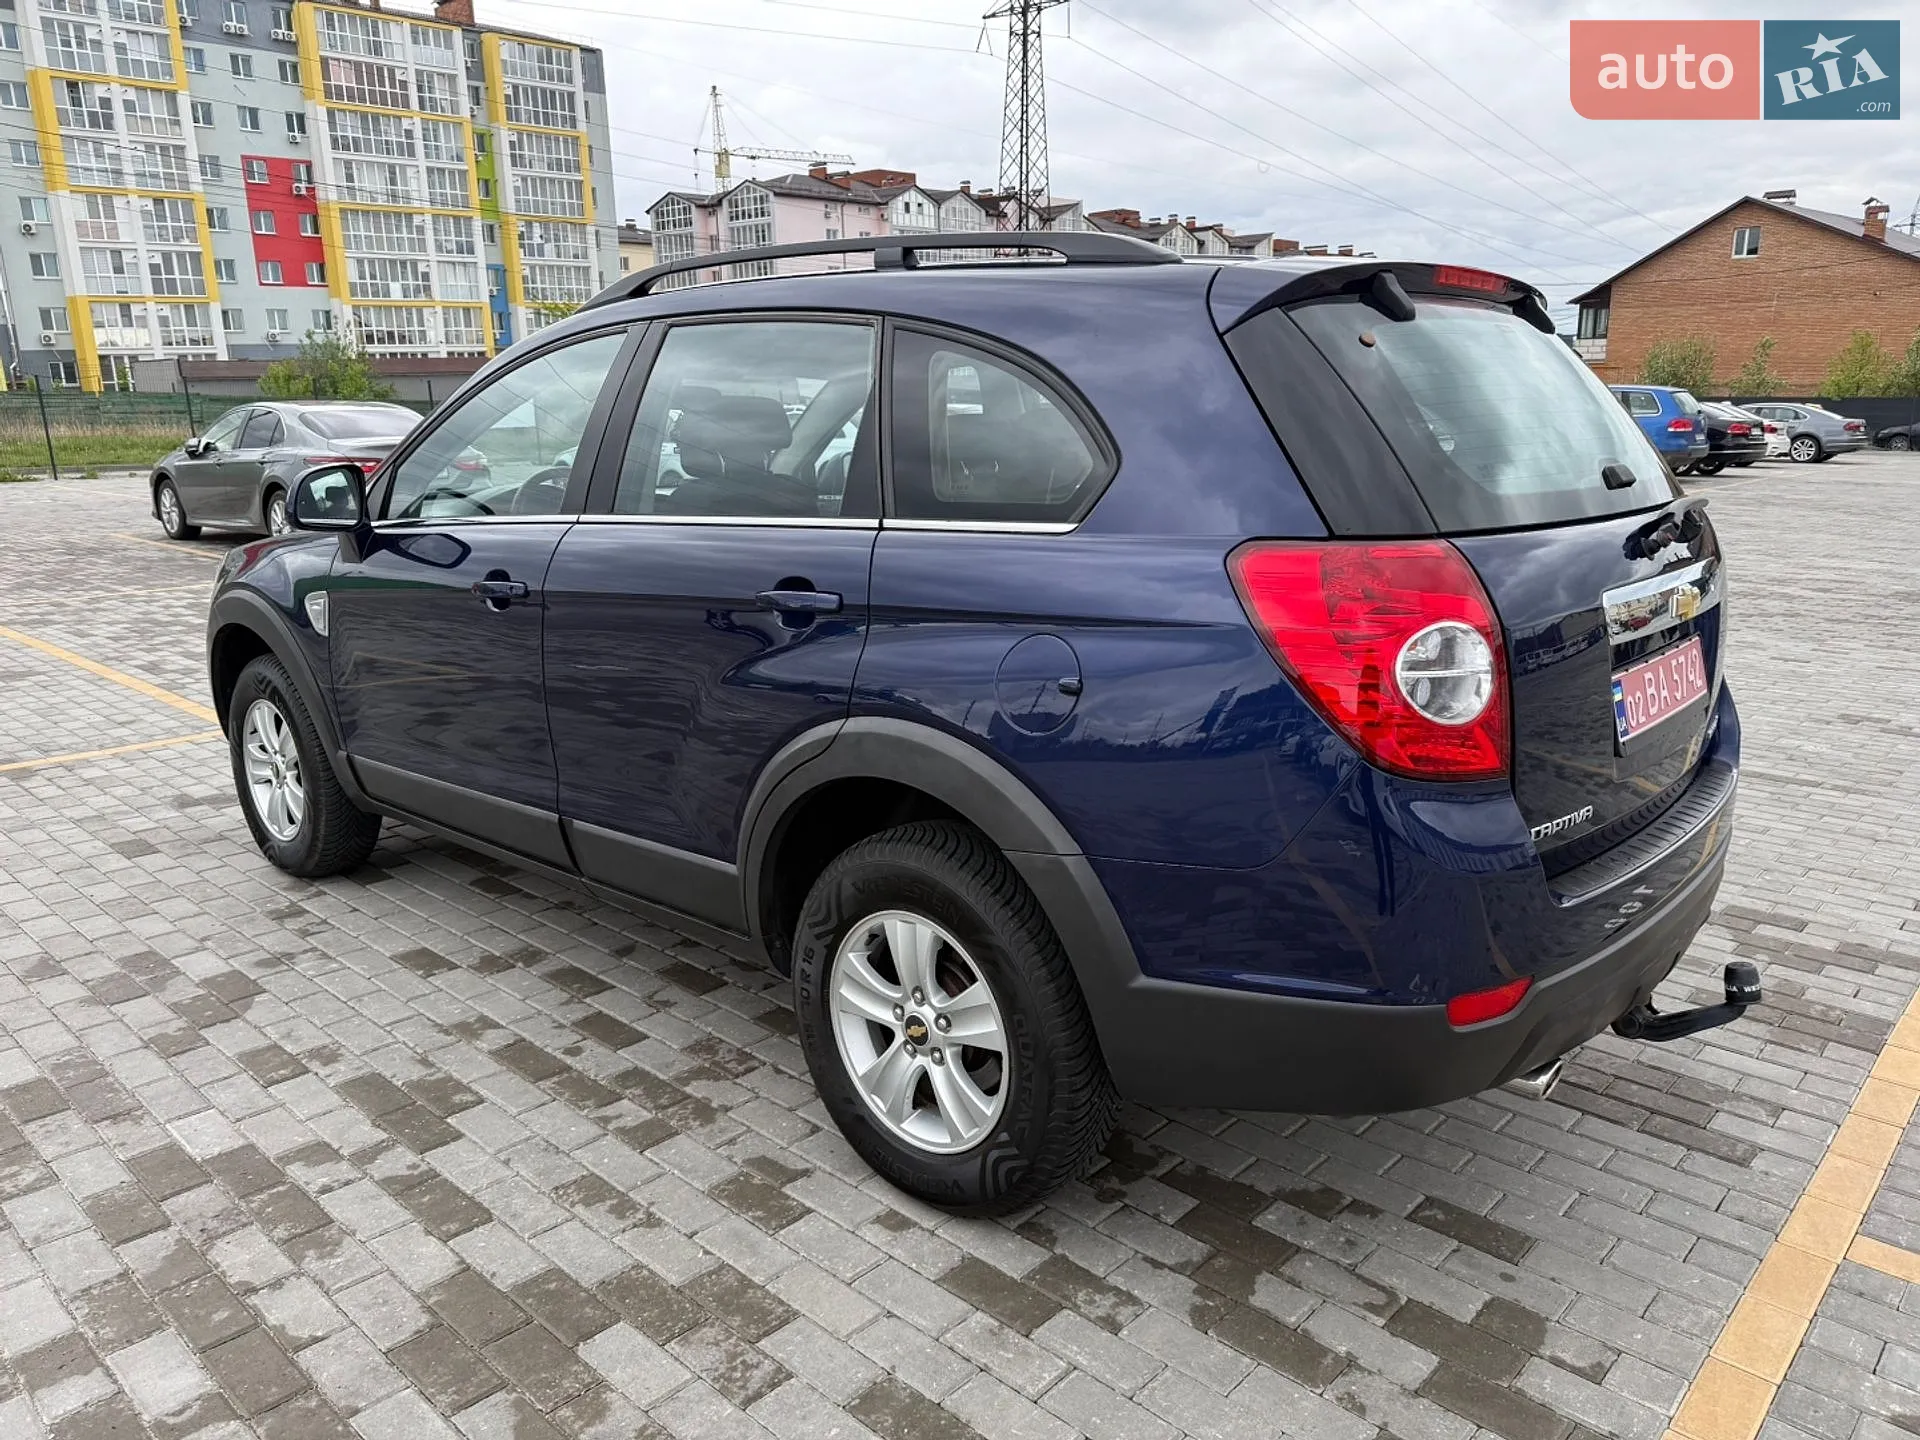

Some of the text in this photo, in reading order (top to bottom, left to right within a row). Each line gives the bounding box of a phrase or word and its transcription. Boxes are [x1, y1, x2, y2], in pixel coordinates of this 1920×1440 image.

[1626, 691, 1647, 728] 02
[1643, 665, 1671, 716] BA
[1670, 647, 1704, 701] 5742
[1530, 805, 1594, 841] CAPTIVA
